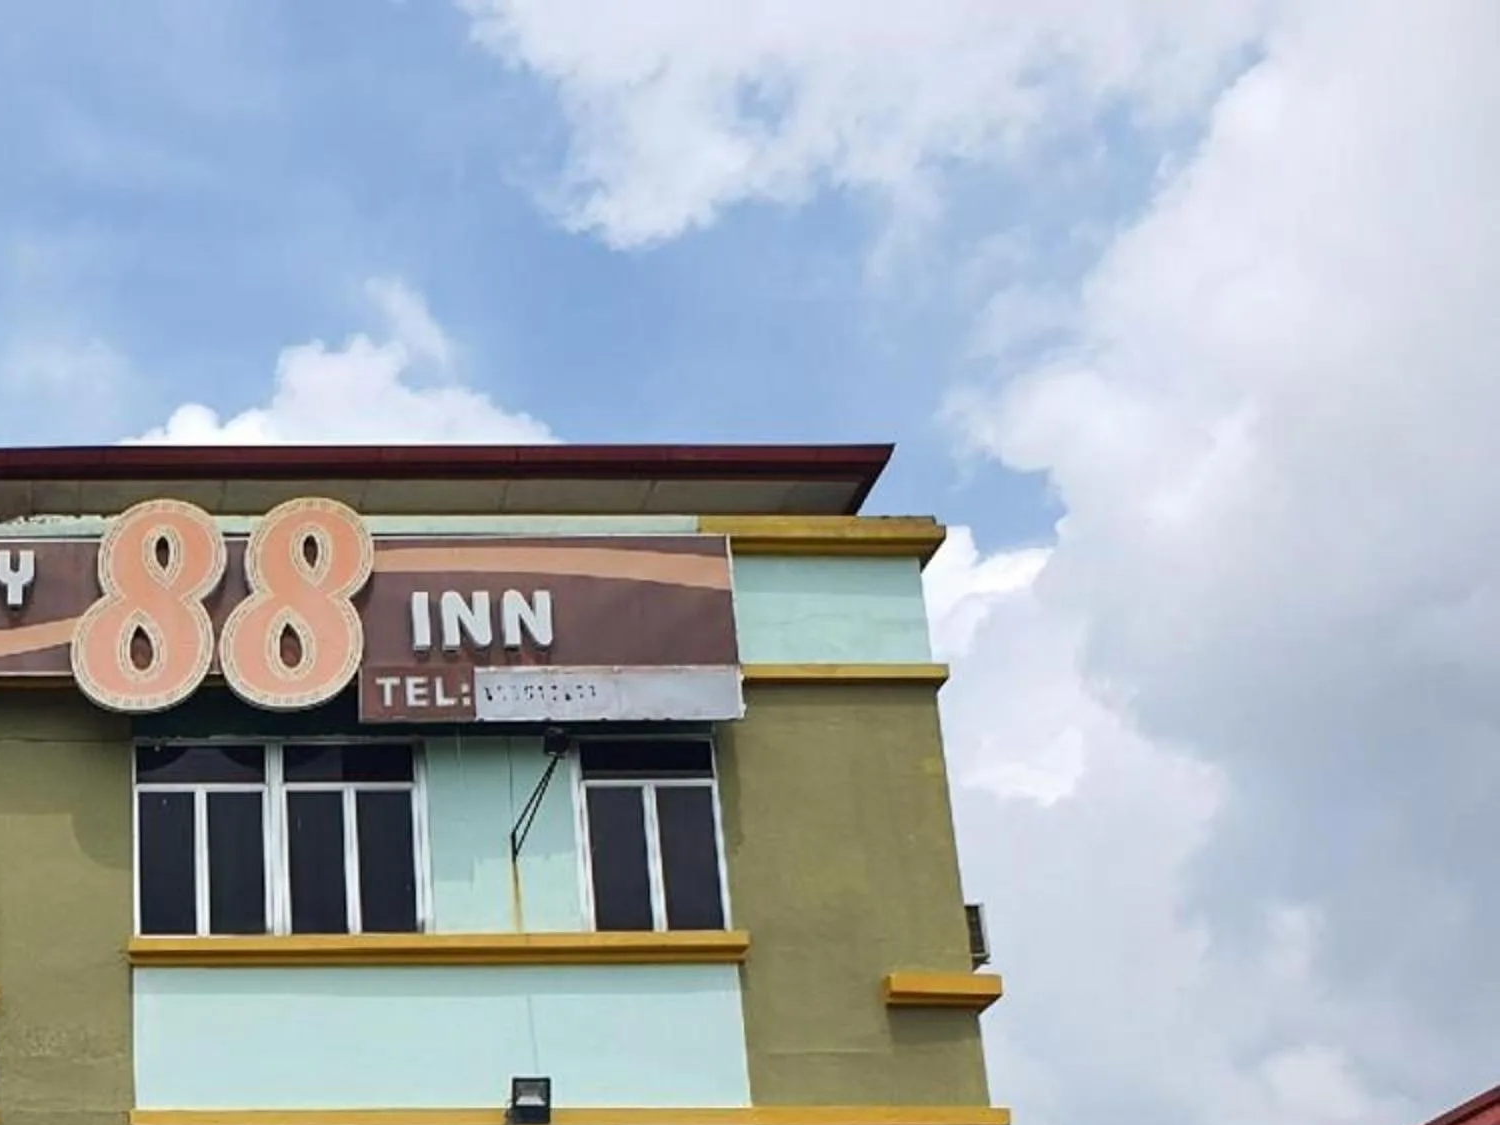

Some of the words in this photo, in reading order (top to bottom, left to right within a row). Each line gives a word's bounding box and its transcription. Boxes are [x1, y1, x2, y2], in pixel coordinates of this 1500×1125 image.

[71, 497, 374, 713] 88
[411, 588, 555, 652] INN
[375, 675, 472, 708] TEL:
